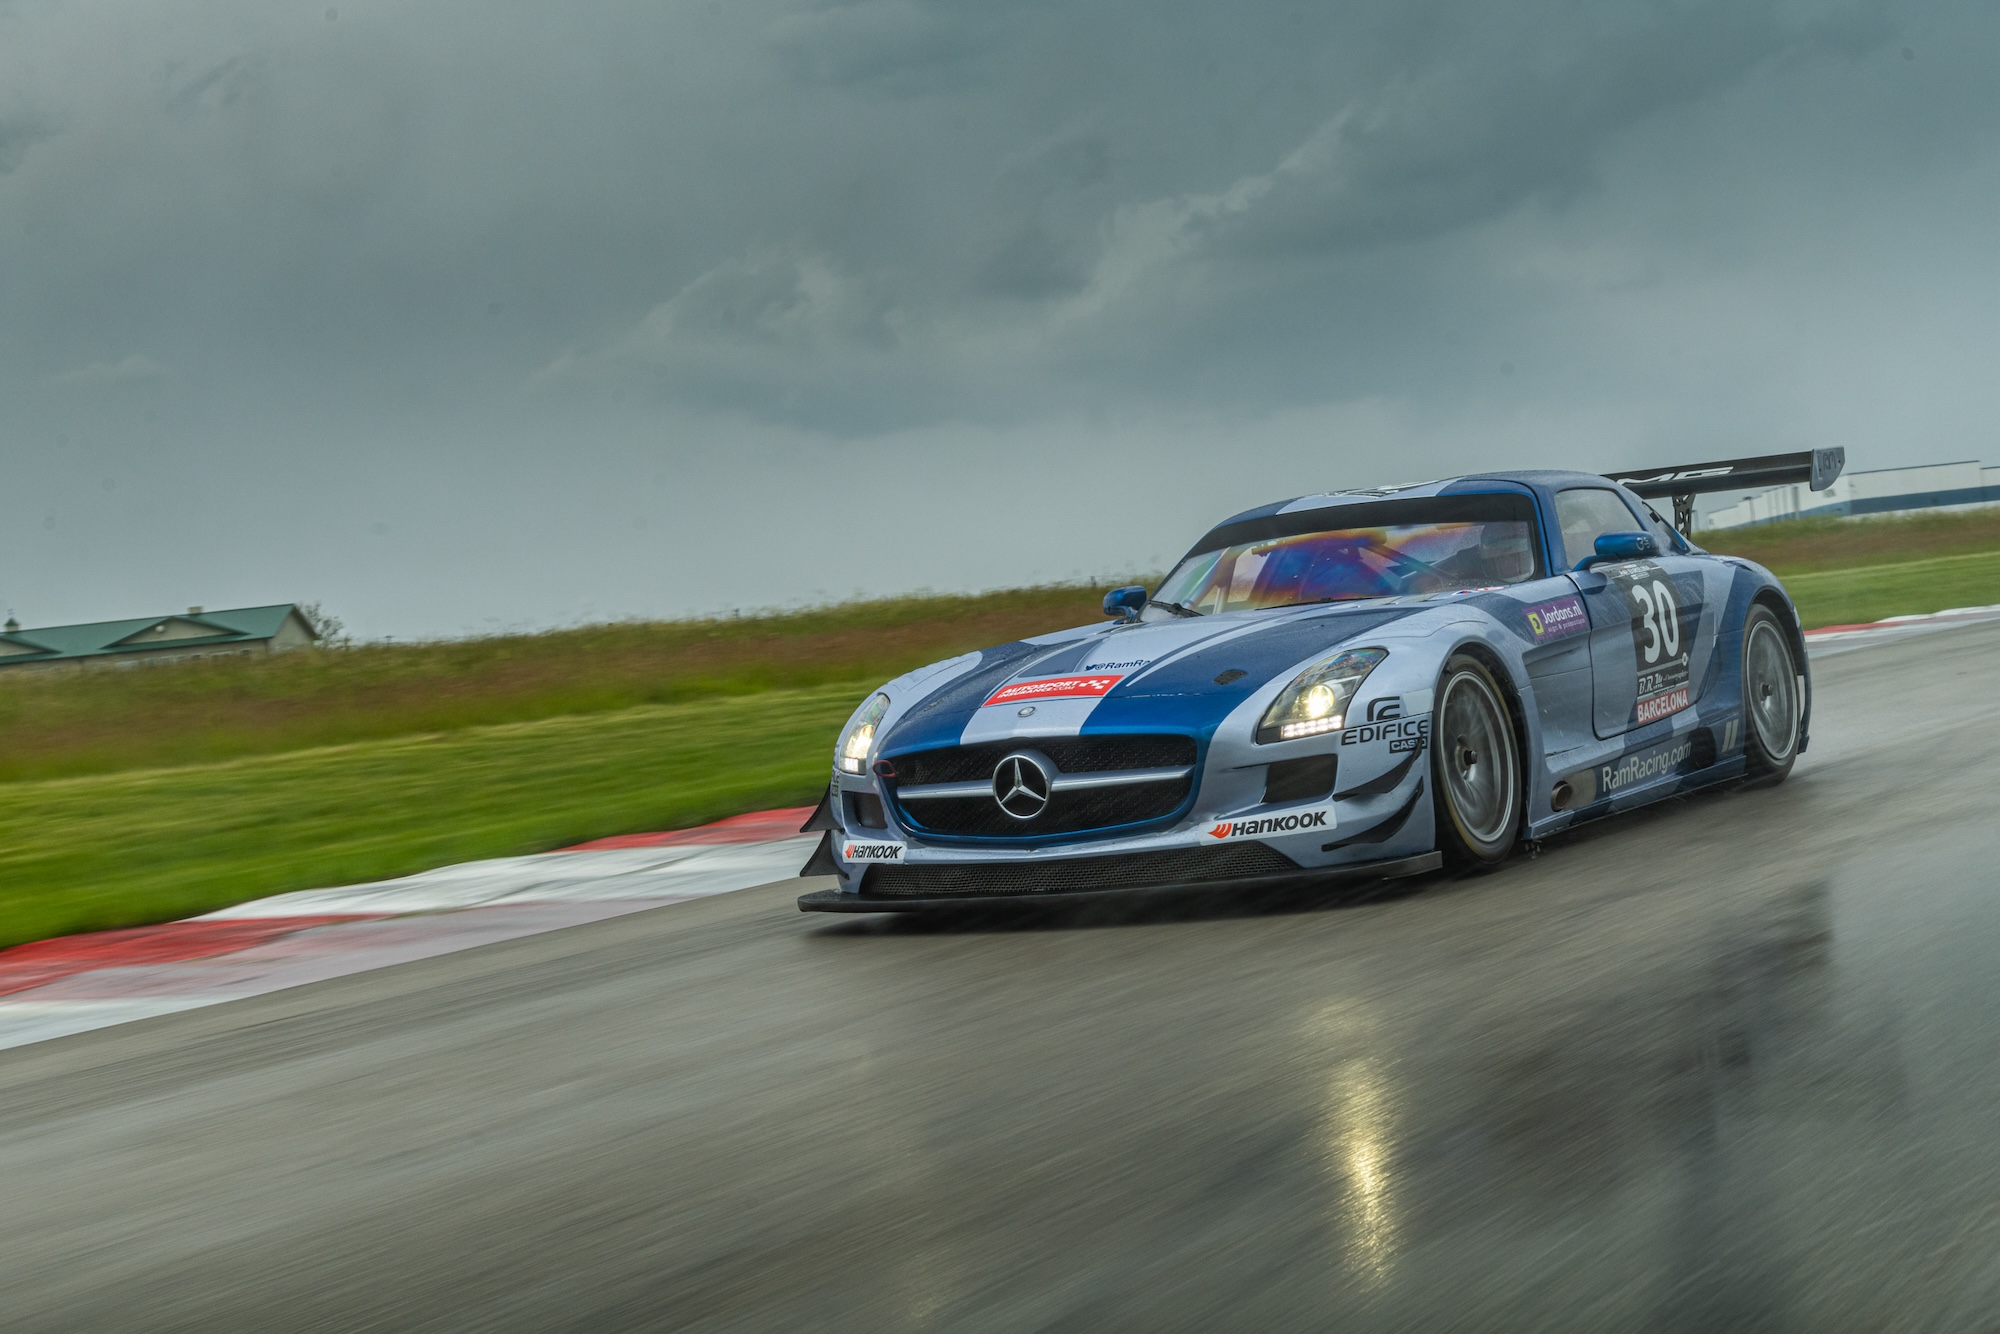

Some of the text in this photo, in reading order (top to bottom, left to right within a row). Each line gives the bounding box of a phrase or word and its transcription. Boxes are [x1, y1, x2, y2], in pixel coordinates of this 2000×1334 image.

[1541, 600, 1583, 624] Jordans.nl
[1632, 580, 1680, 664] 30
[1001, 680, 1082, 695] AUTOSPORT
[1637, 689, 1689, 722] BARCELONA
[1341, 719, 1430, 746] EDIFICE
[1602, 741, 1693, 793] RamRacing.com
